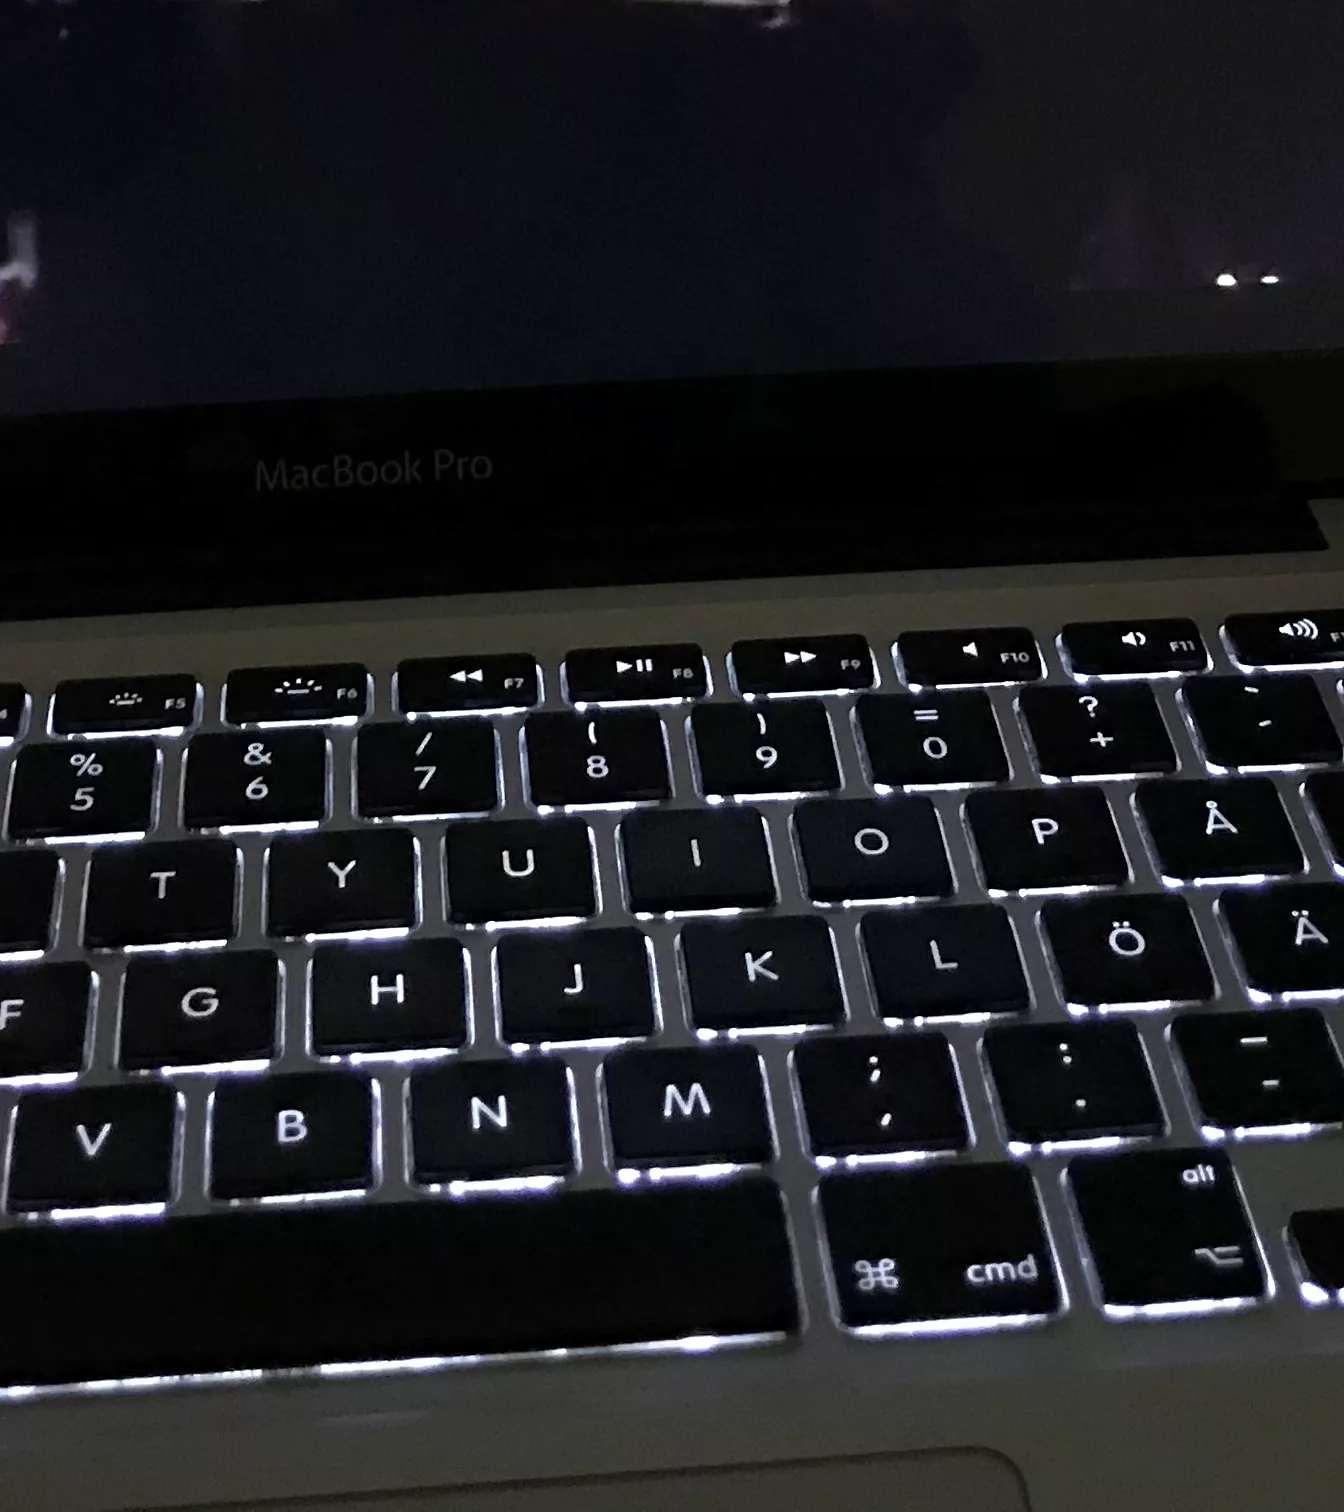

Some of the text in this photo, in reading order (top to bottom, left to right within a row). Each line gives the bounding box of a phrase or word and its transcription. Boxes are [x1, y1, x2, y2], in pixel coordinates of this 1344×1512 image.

[255, 447, 494, 493] MacBook Pro
[999, 651, 1030, 664] F10
[1169, 640, 1196, 653] F11
[840, 659, 861, 671] F9
[503, 677, 525, 690] F7
[164, 697, 186, 710] F5
[1078, 695, 1099, 718] ?
[69, 752, 104, 777] %
[243, 742, 273, 766] &
[586, 754, 610, 779] 8
[755, 745, 779, 769] 9
[245, 775, 269, 800] 6
[413, 765, 437, 791] 7
[69, 786, 95, 812] 5
[1030, 817, 1059, 846] P
[1205, 800, 1239, 836] Å
[690, 838, 702, 868] I
[854, 827, 890, 856] O
[327, 859, 357, 889] Y
[501, 848, 535, 878] U
[149, 870, 177, 900] T
[1108, 920, 1146, 958] Ö
[1290, 909, 1329, 947] Ä
[744, 950, 780, 983] K
[929, 939, 959, 970] L
[370, 973, 405, 1007] H
[563, 962, 584, 996] J
[180, 986, 220, 1019] G
[470, 1094, 508, 1132] N
[662, 1082, 712, 1120] M
[75, 1122, 113, 1158] V
[276, 1109, 308, 1145] B
[1181, 1163, 1216, 1186] alt
[965, 1253, 1039, 1287] cmd
